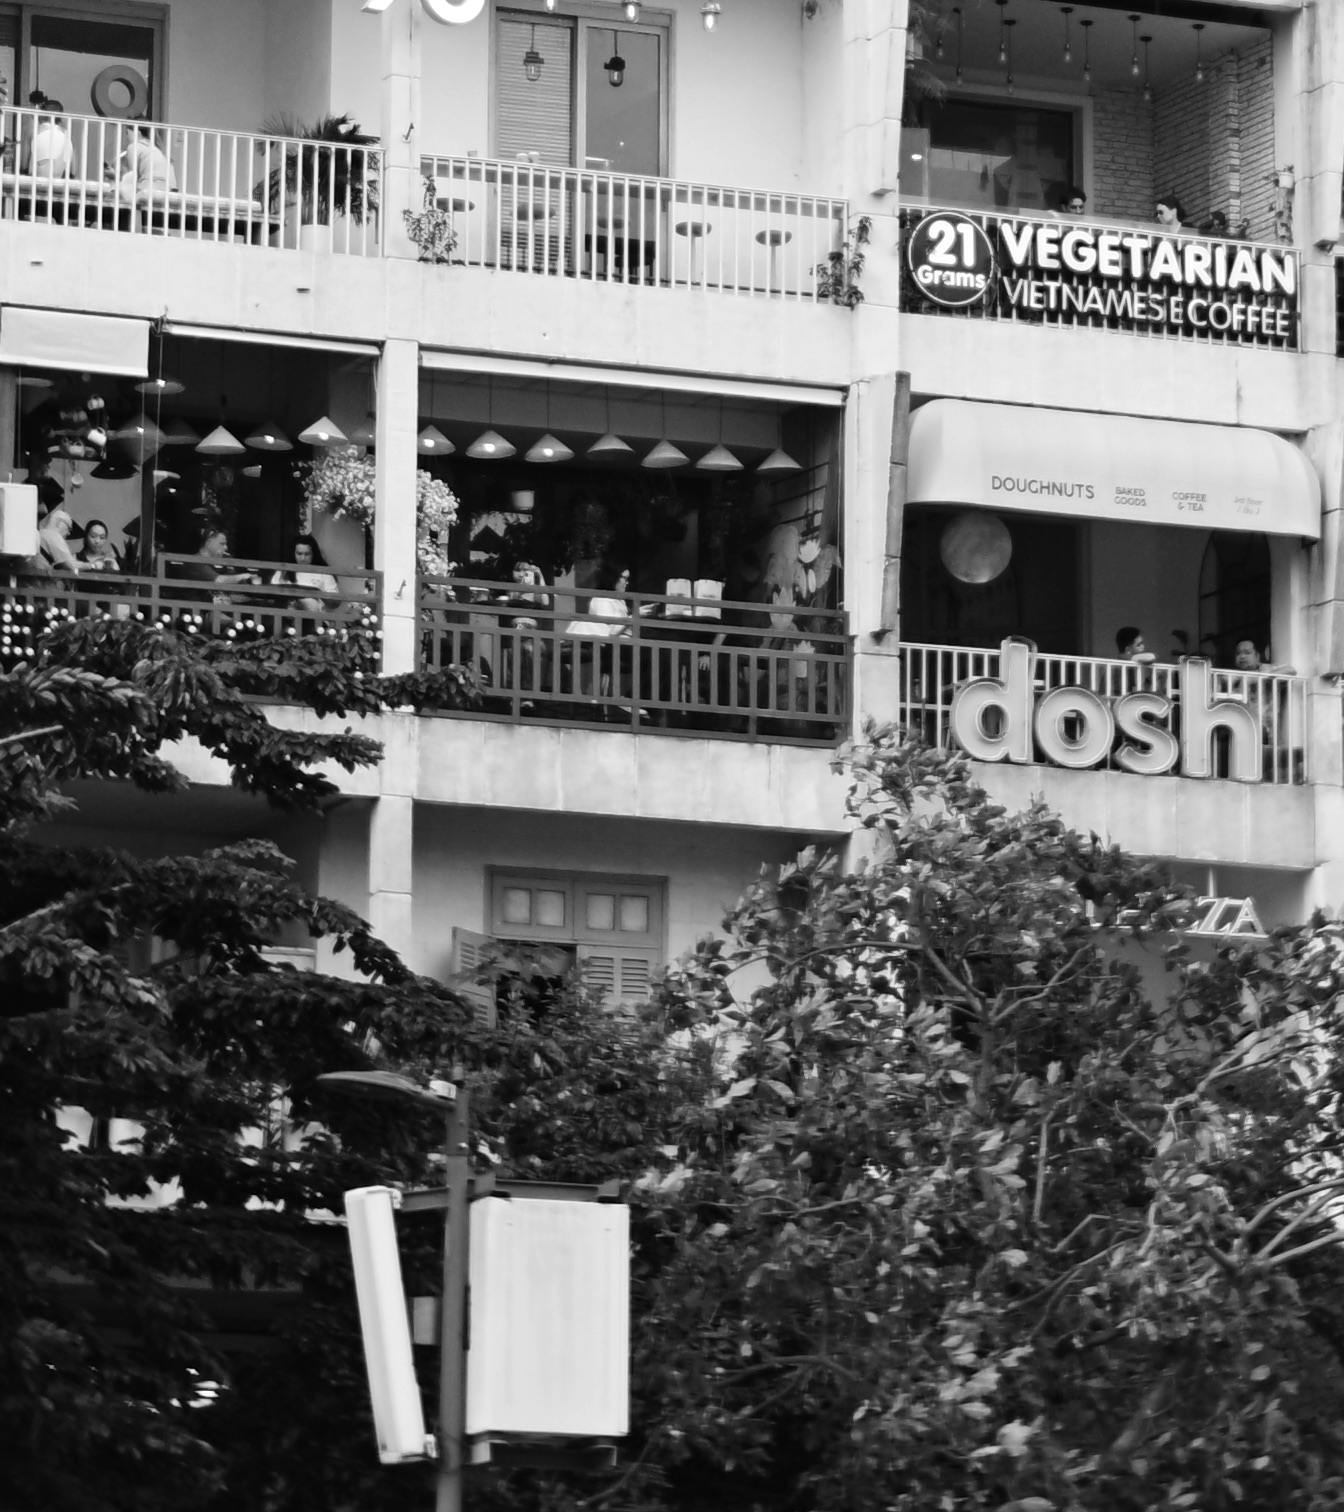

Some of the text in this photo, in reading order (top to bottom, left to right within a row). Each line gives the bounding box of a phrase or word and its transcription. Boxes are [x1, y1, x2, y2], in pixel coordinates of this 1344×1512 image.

[928, 219, 978, 267] 21
[1001, 223, 1296, 295] VEGETARIAN
[917, 265, 986, 290] Grams
[1003, 276, 1291, 337] VIETNAMESE COFFEE
[991, 475, 1096, 500] DOUGHNUTS
[1115, 486, 1146, 497] BAKED
[1171, 491, 1207, 503] COFFEE
[1114, 496, 1147, 507] GOODS
[1188, 502, 1204, 512] TEA
[952, 636, 1263, 781] dosh
